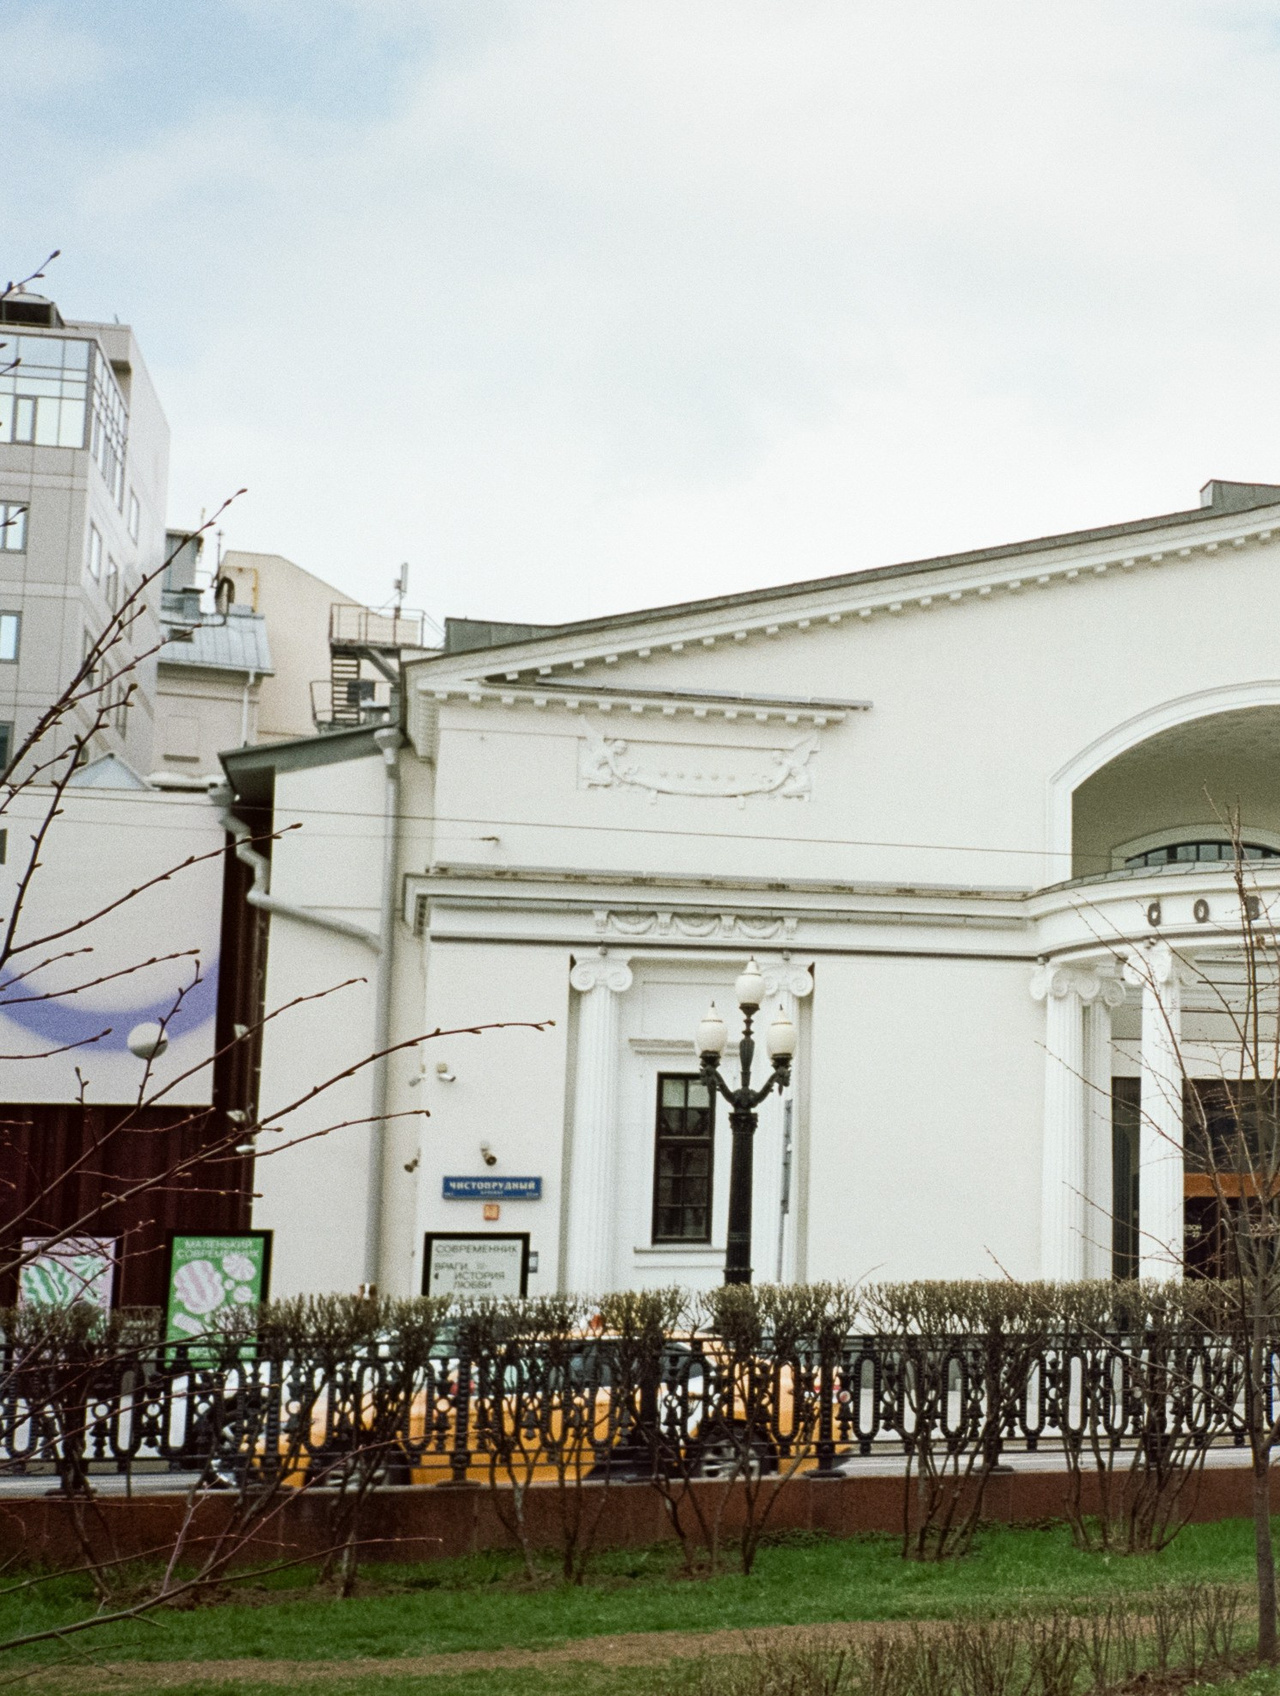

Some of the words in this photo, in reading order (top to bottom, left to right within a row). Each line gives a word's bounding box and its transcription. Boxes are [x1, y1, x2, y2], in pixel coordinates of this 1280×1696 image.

[449, 1181, 536, 1190] ЧИСТОПРУДНЫЙ
[435, 1244, 517, 1254] СОВРЕМЕННИК
[434, 1262, 468, 1270] ВРАГИ
[454, 1271, 505, 1280] ИСТОРИЯ
[453, 1281, 492, 1289] ЛЮБВИ
